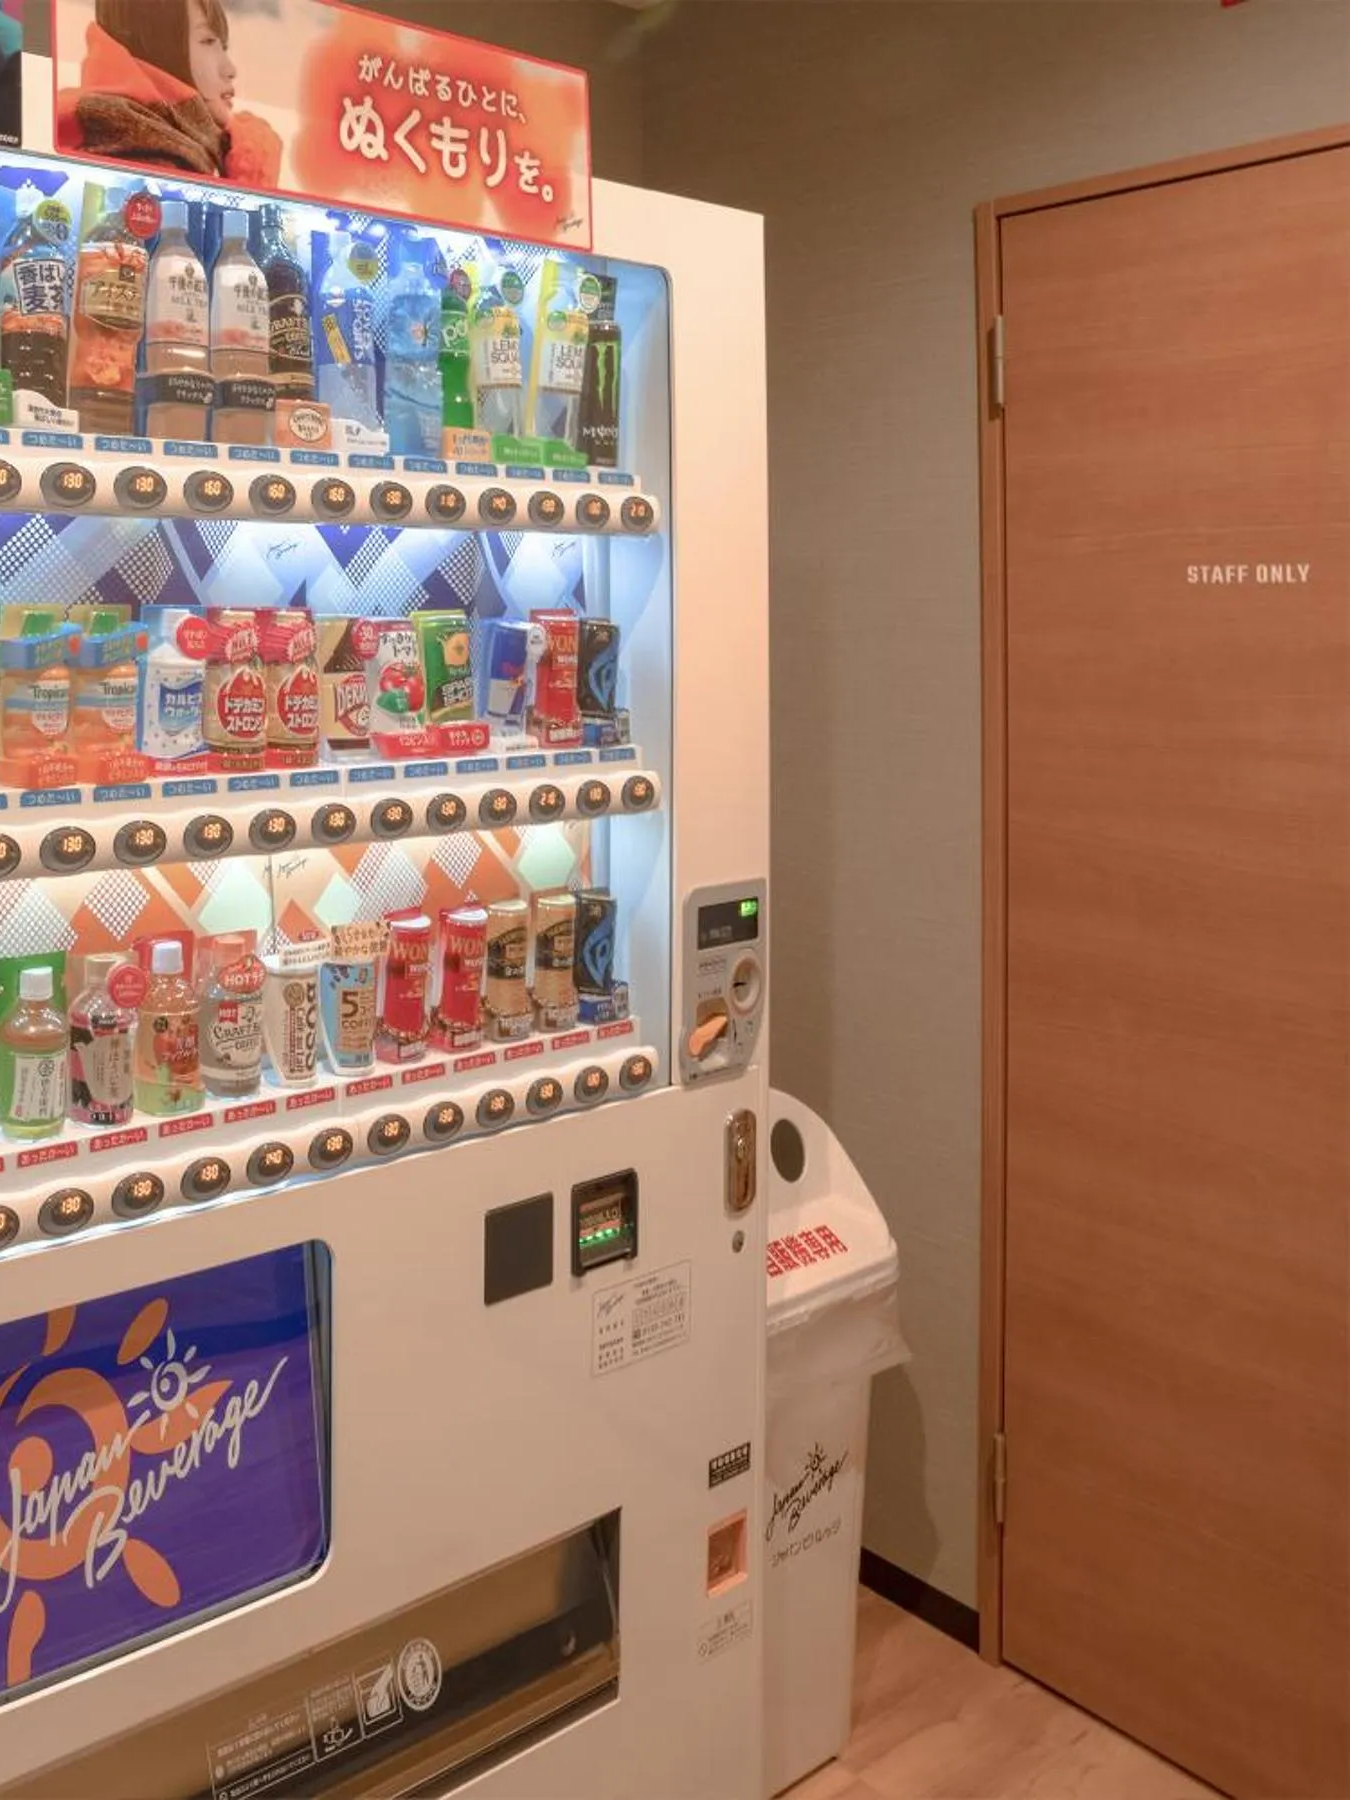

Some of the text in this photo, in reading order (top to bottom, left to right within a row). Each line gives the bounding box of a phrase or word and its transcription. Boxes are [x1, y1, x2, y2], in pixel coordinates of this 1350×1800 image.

[358, 53, 527, 124] がんばるひとに、
[338, 95, 554, 203] ぬくもりを。
[1187, 563, 1310, 584] STAFF ONLY
[63, 835, 82, 852] 130
[341, 991, 359, 1018] 5
[62, 1196, 81, 1214] 130
[62, 1356, 289, 1589] Beverage
